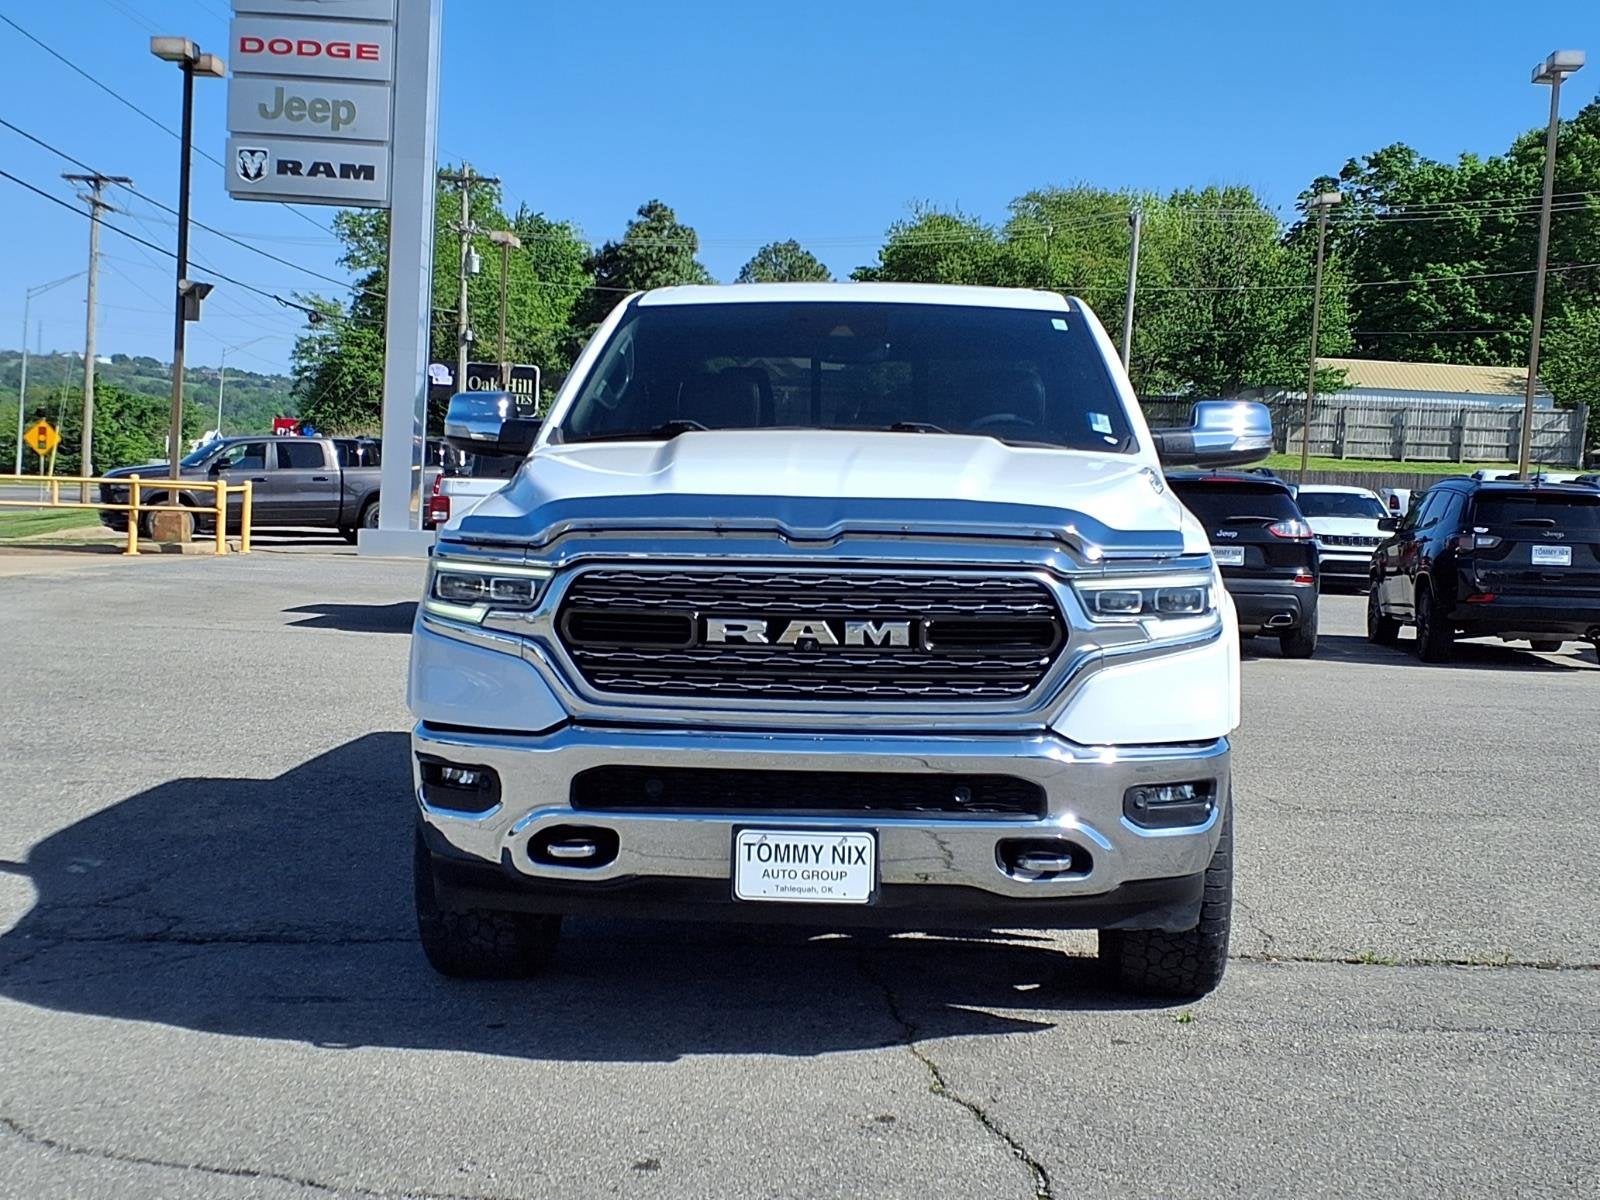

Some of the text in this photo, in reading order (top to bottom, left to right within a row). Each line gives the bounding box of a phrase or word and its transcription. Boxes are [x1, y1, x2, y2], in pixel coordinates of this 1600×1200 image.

[239, 36, 380, 61] DODGE
[258, 86, 357, 131] Jeep
[276, 159, 375, 181] RAM
[468, 375, 533, 394] Oak Hill
[706, 618, 910, 646] RAM
[743, 842, 867, 865] TOMMY NIX
[762, 869, 848, 881] AUTO GROUP
[775, 885, 834, 894] Tahlequah, OK
